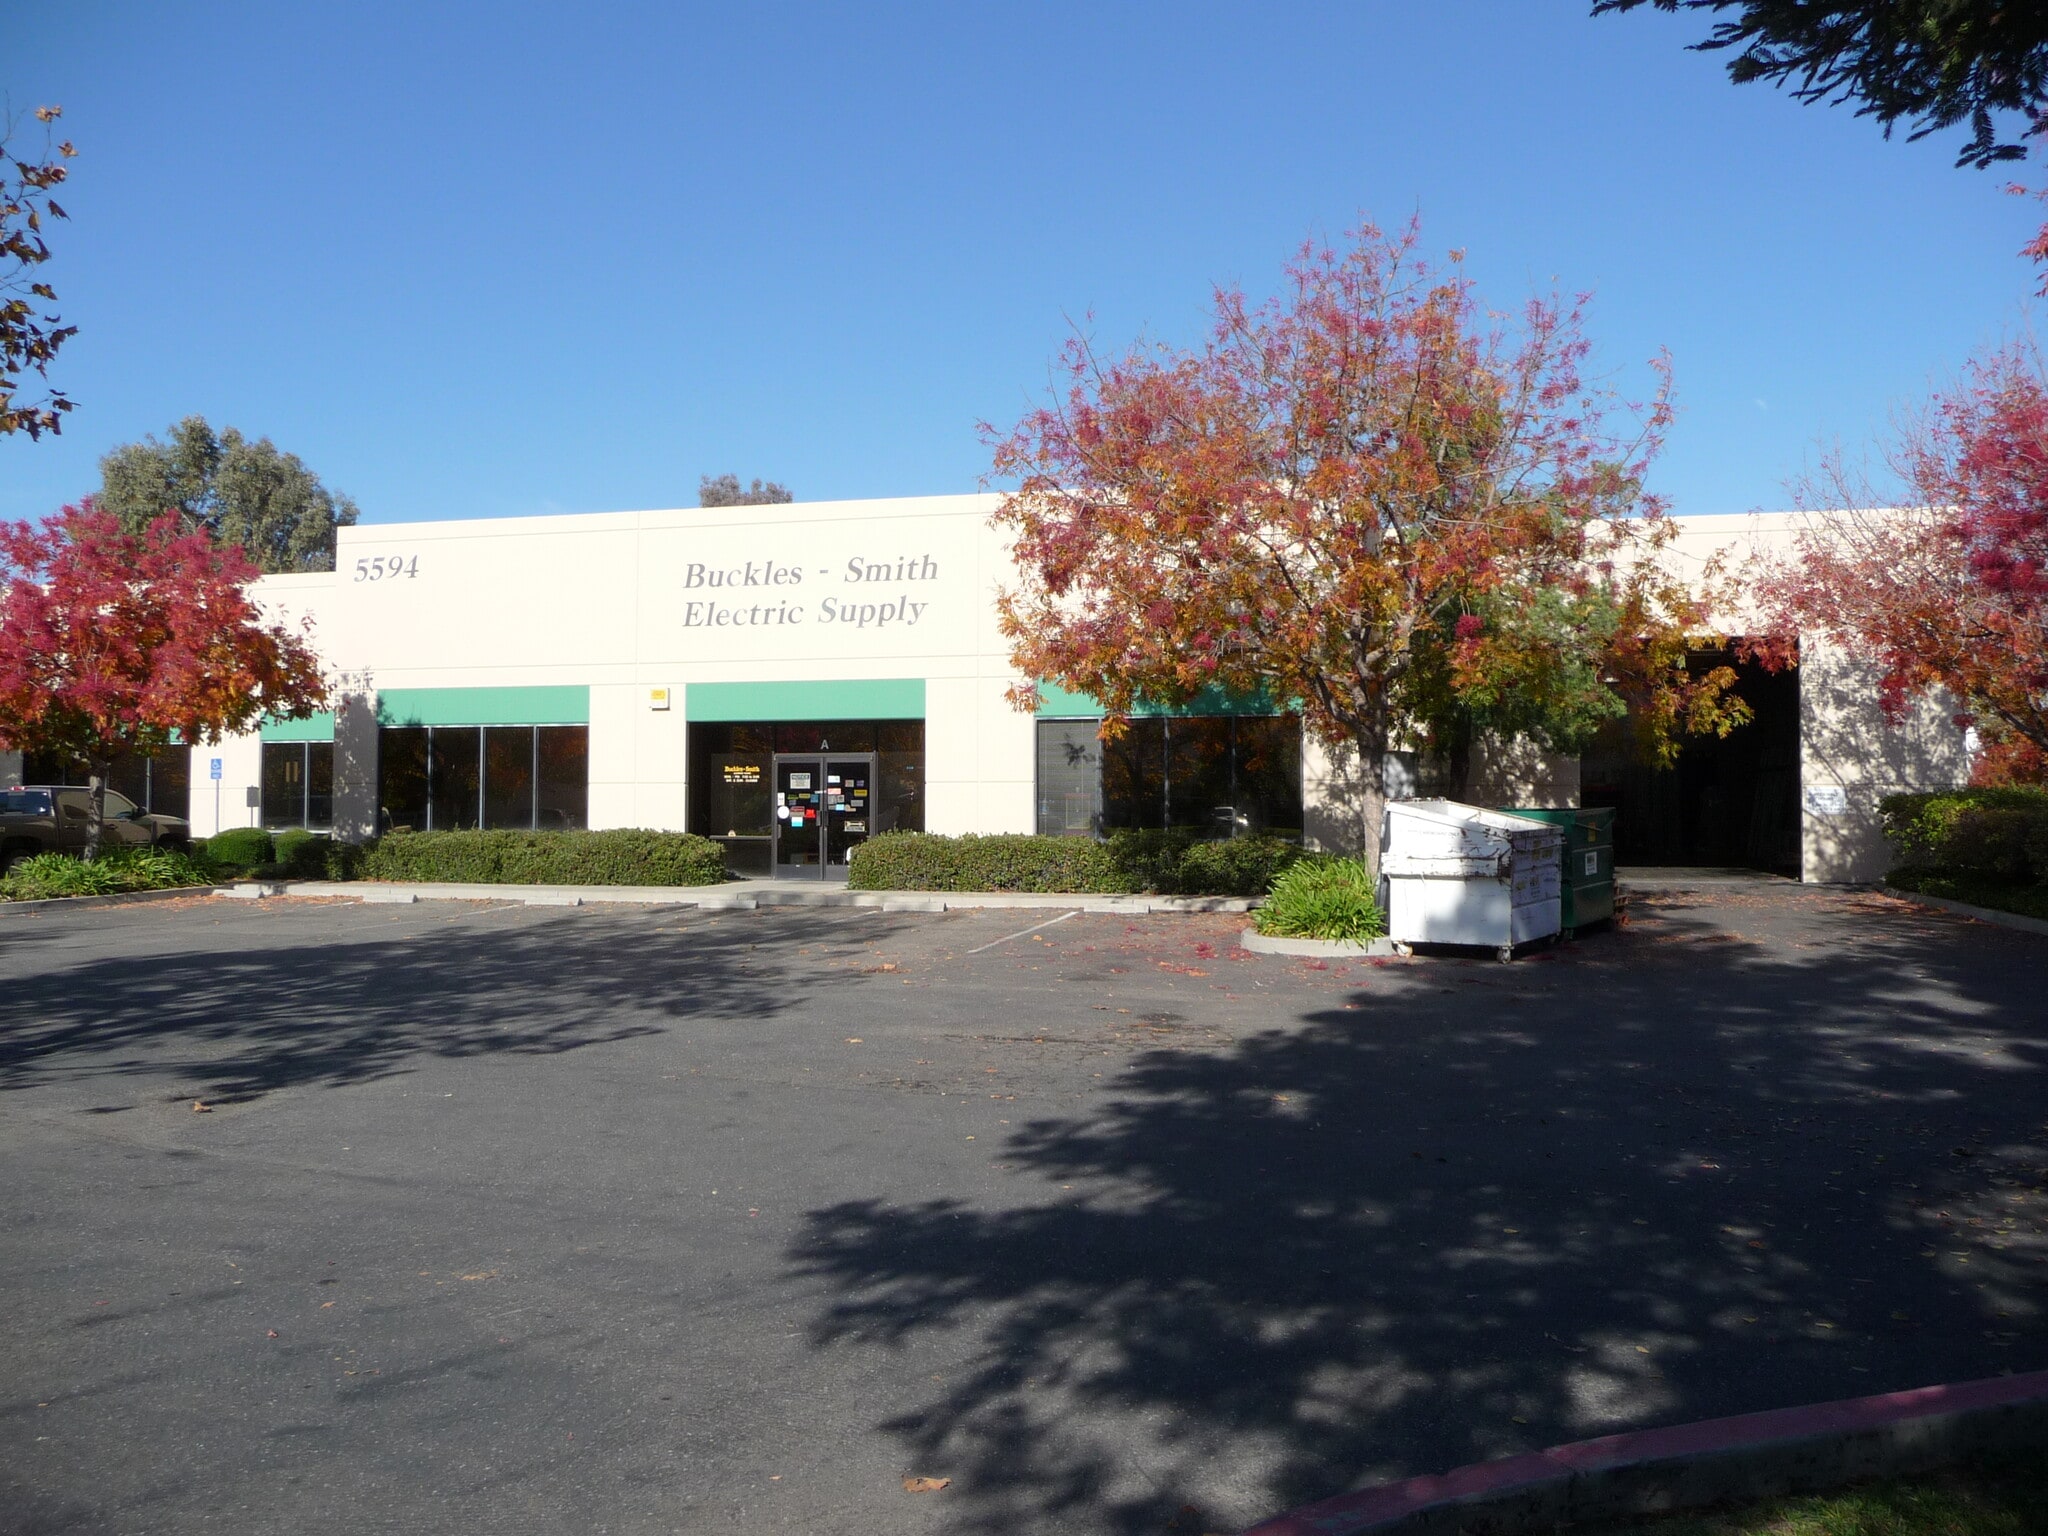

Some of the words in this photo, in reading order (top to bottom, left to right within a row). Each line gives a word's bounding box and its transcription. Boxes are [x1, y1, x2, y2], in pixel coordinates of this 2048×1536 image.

[354, 556, 420, 582] 5594
[683, 561, 803, 588] Buckles
[844, 554, 938, 583] Smith
[682, 600, 803, 627] Electric
[818, 595, 927, 629] Supply
[820, 739, 830, 750] A
